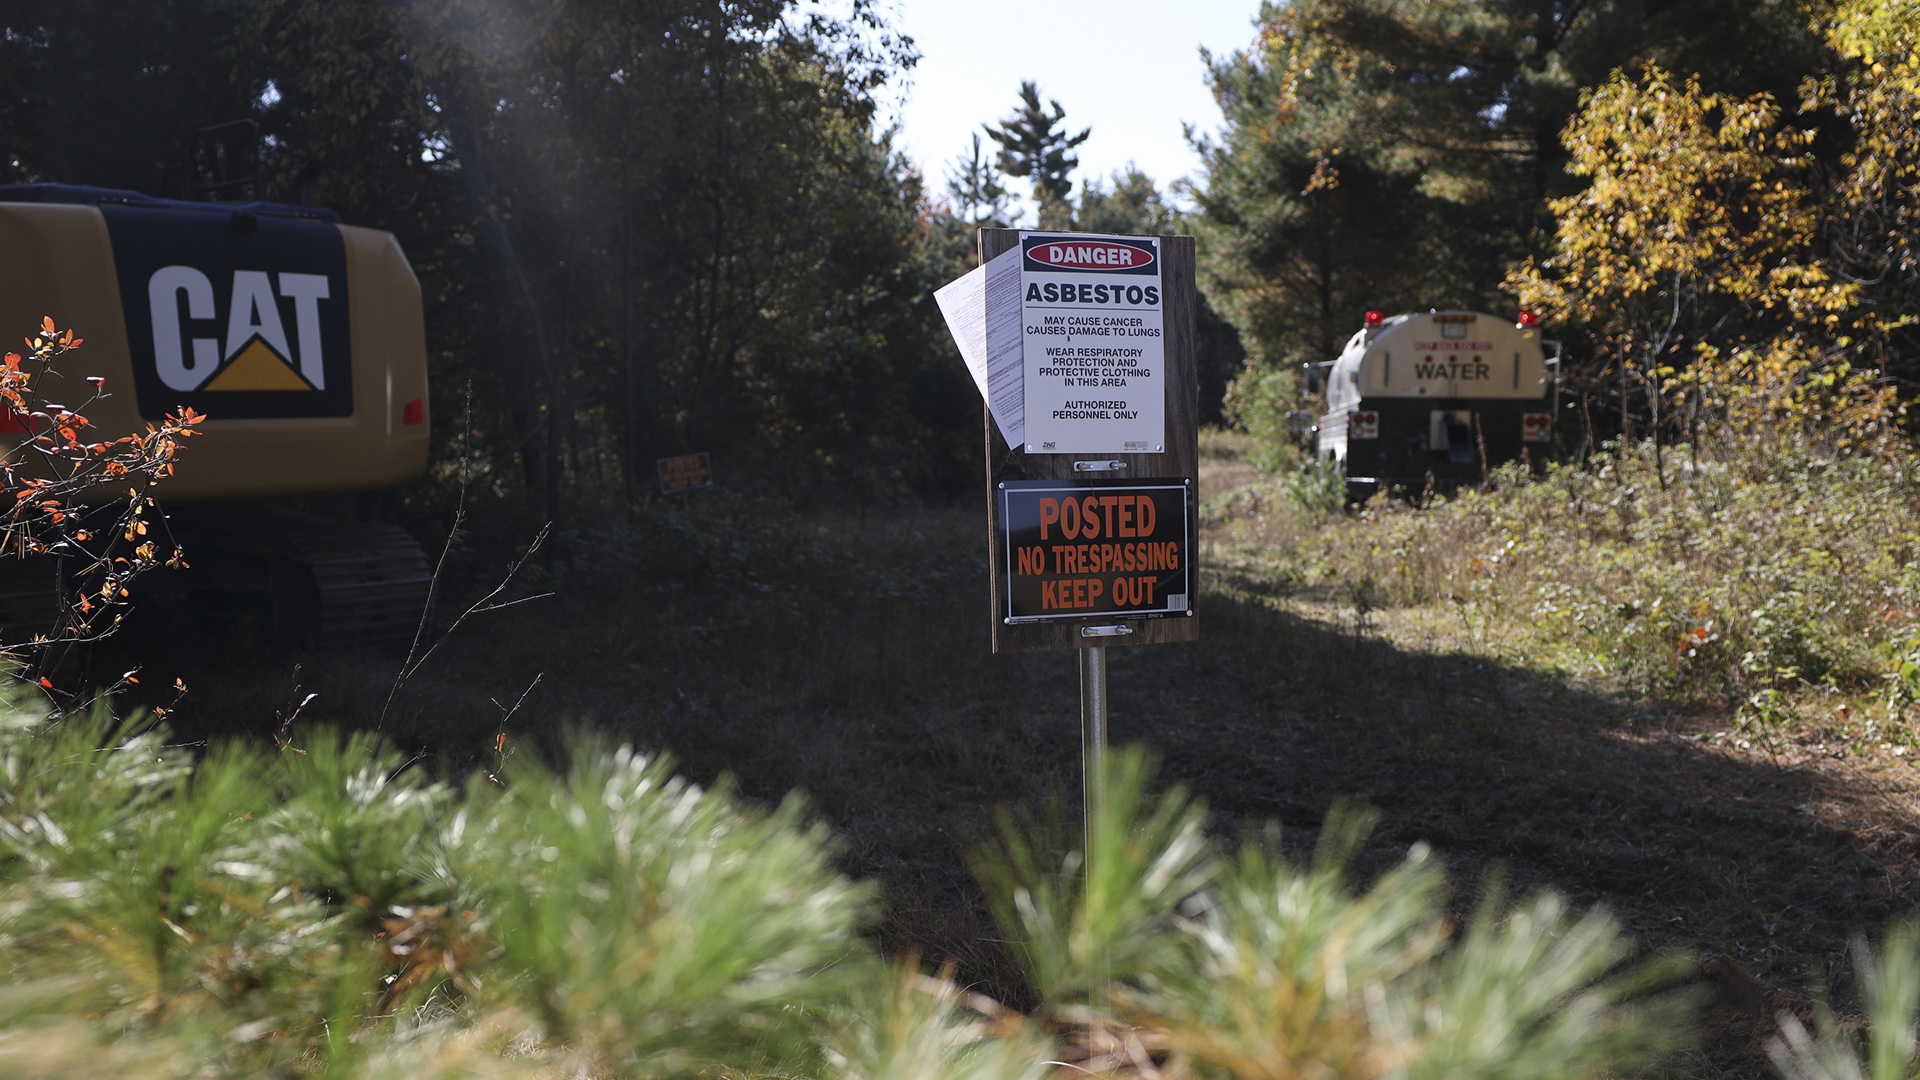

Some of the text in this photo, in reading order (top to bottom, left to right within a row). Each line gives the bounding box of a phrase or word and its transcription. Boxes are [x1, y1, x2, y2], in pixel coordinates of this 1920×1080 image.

[1049, 246, 1133, 265] DANGER
[1025, 282, 1160, 305] ASBESTOS
[1044, 316, 1143, 327] MAY CAUSE CANCER
[148, 264, 331, 392] CAT
[1026, 326, 1160, 337] CAUSES DAMAGE TO LUNGS
[1046, 348, 1143, 358] WEAR RESPIRATORY
[1052, 358, 1137, 367] PROTECTION AND
[1039, 368, 1150, 377] PROTECTIVE CLOTHING
[1415, 363, 1490, 379] WATER
[1064, 378, 1127, 387] IN THIS AREA
[1064, 401, 1127, 410] AUTHORIZED
[1052, 411, 1138, 420] PERSONNEL ONLY
[1039, 495, 1156, 540] POSTED
[1018, 541, 1179, 576] NO TRESPASSING
[1041, 576, 1157, 610] KEEP OUT
